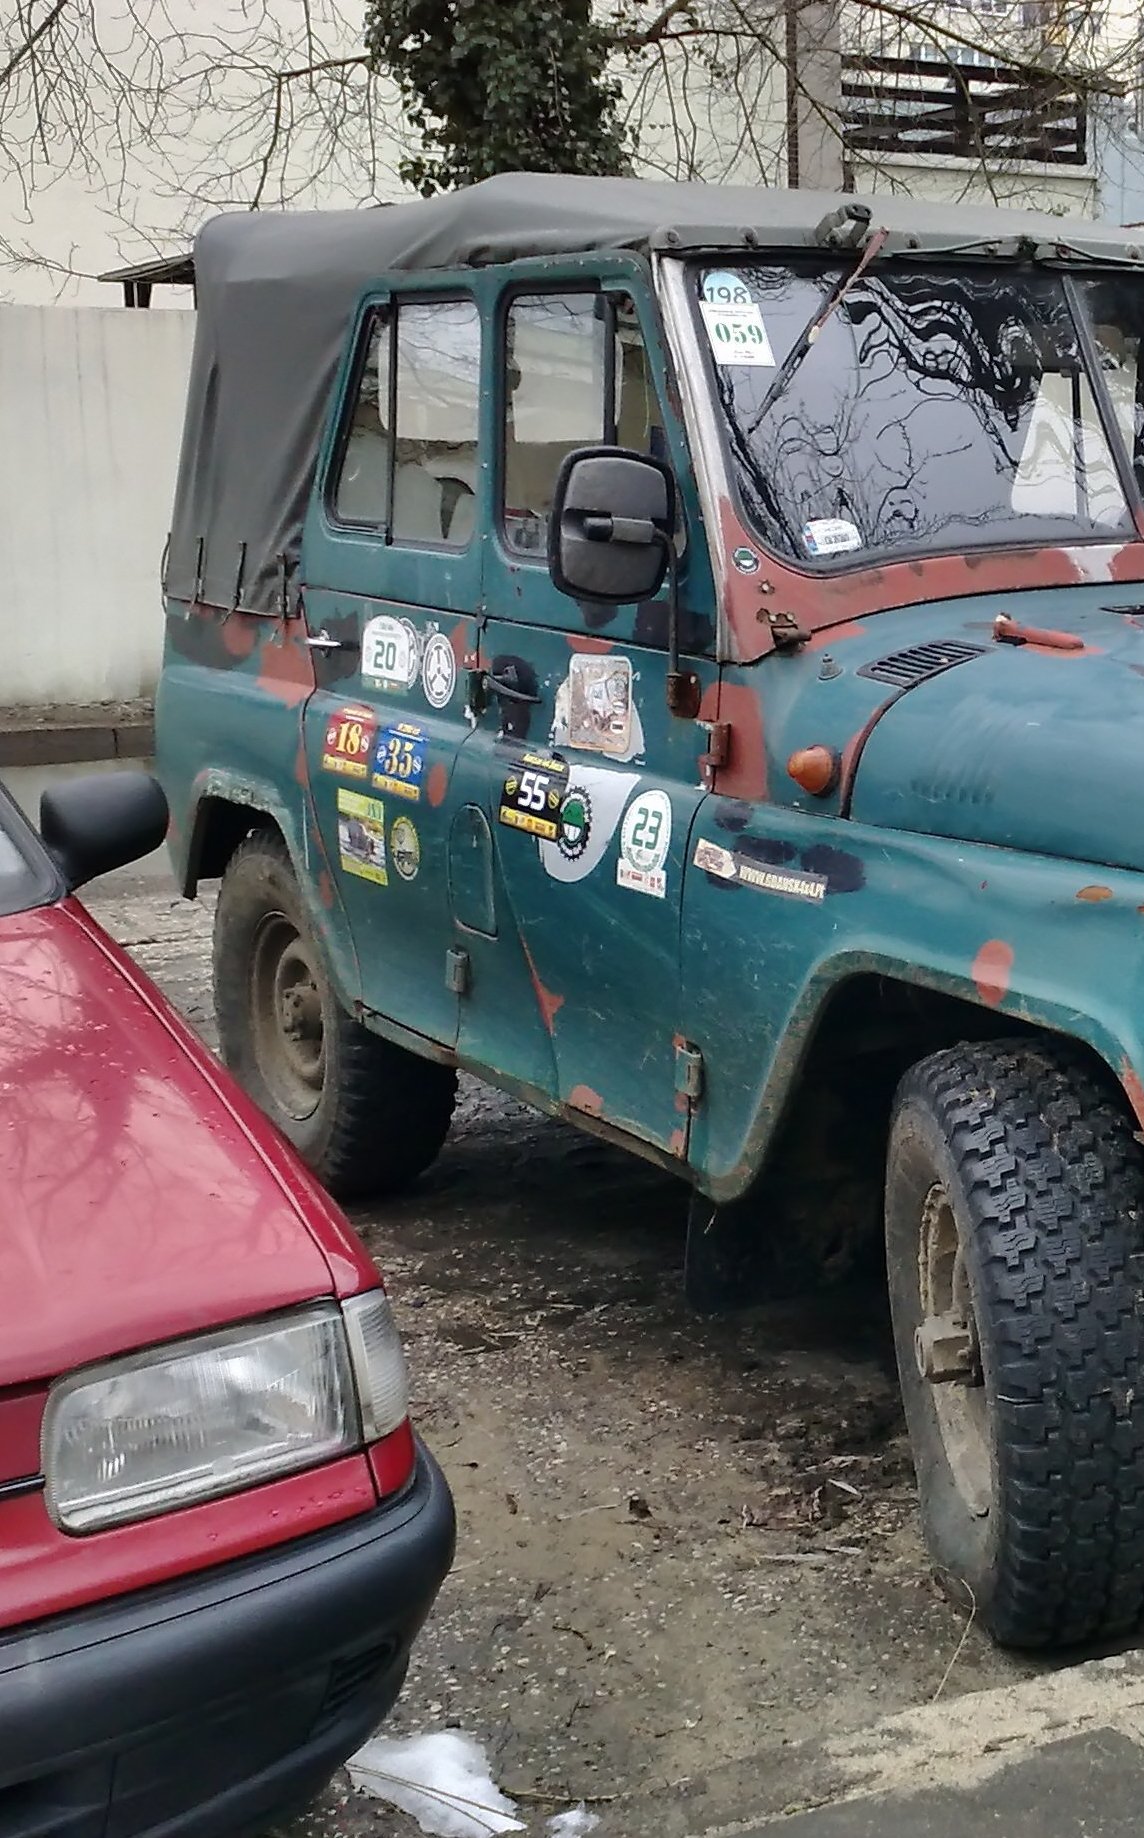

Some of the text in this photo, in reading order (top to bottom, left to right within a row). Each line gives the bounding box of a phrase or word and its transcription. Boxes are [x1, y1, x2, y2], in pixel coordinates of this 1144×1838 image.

[715, 323, 763, 345] 059
[373, 640, 397, 671] 20
[335, 721, 363, 755] 18
[384, 737, 416, 778] 35
[517, 770, 550, 811] 55
[631, 806, 663, 850] 23
